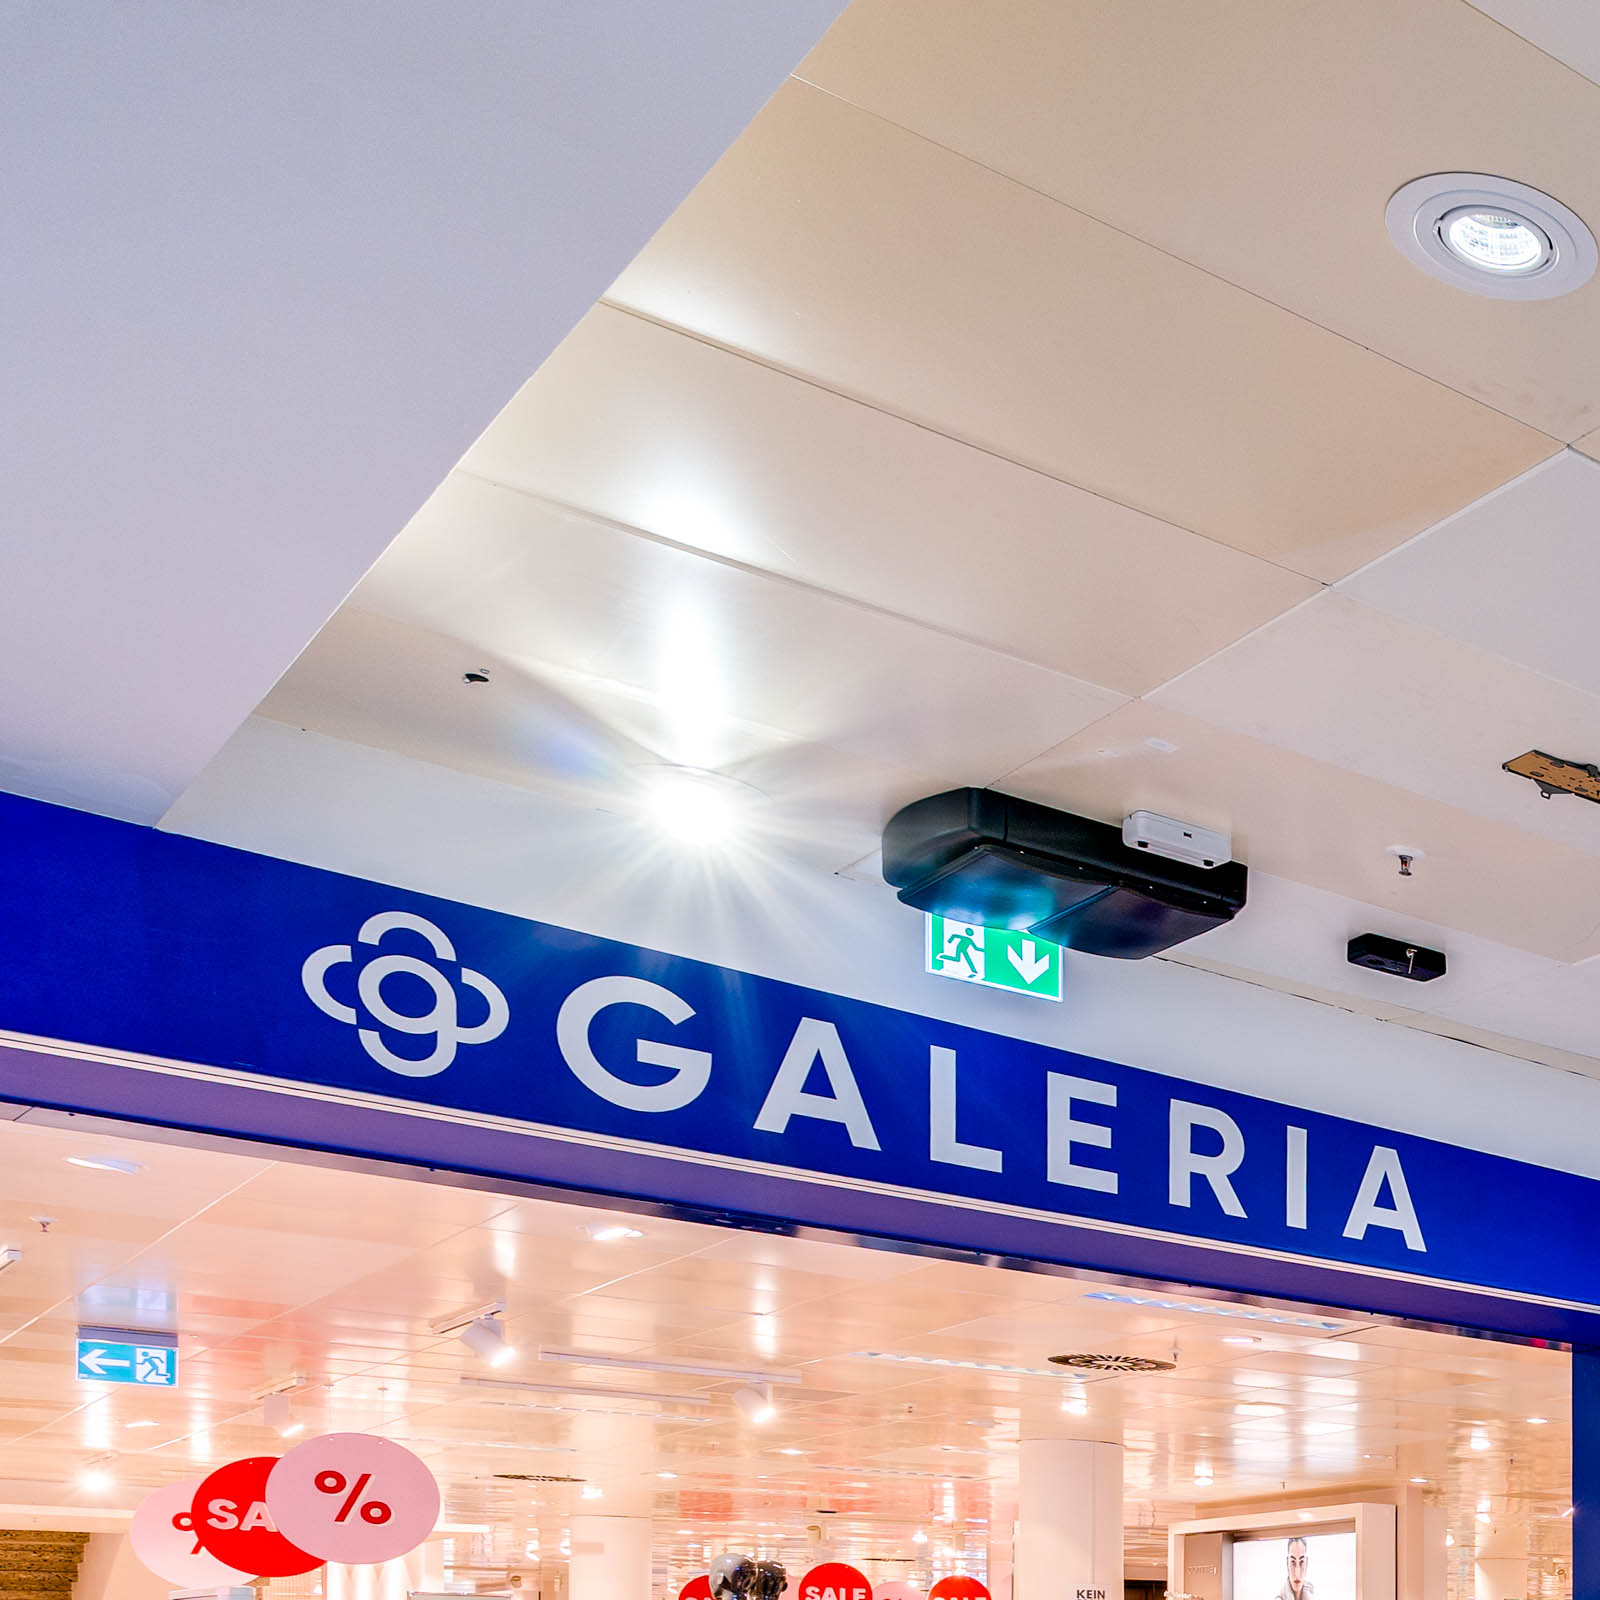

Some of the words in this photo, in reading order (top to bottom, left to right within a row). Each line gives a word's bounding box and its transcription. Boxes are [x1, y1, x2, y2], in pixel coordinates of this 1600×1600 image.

[556, 974, 1429, 1254] GALERIA
[314, 1470, 391, 1525] %
[1076, 1589, 1106, 1600] KEIN
